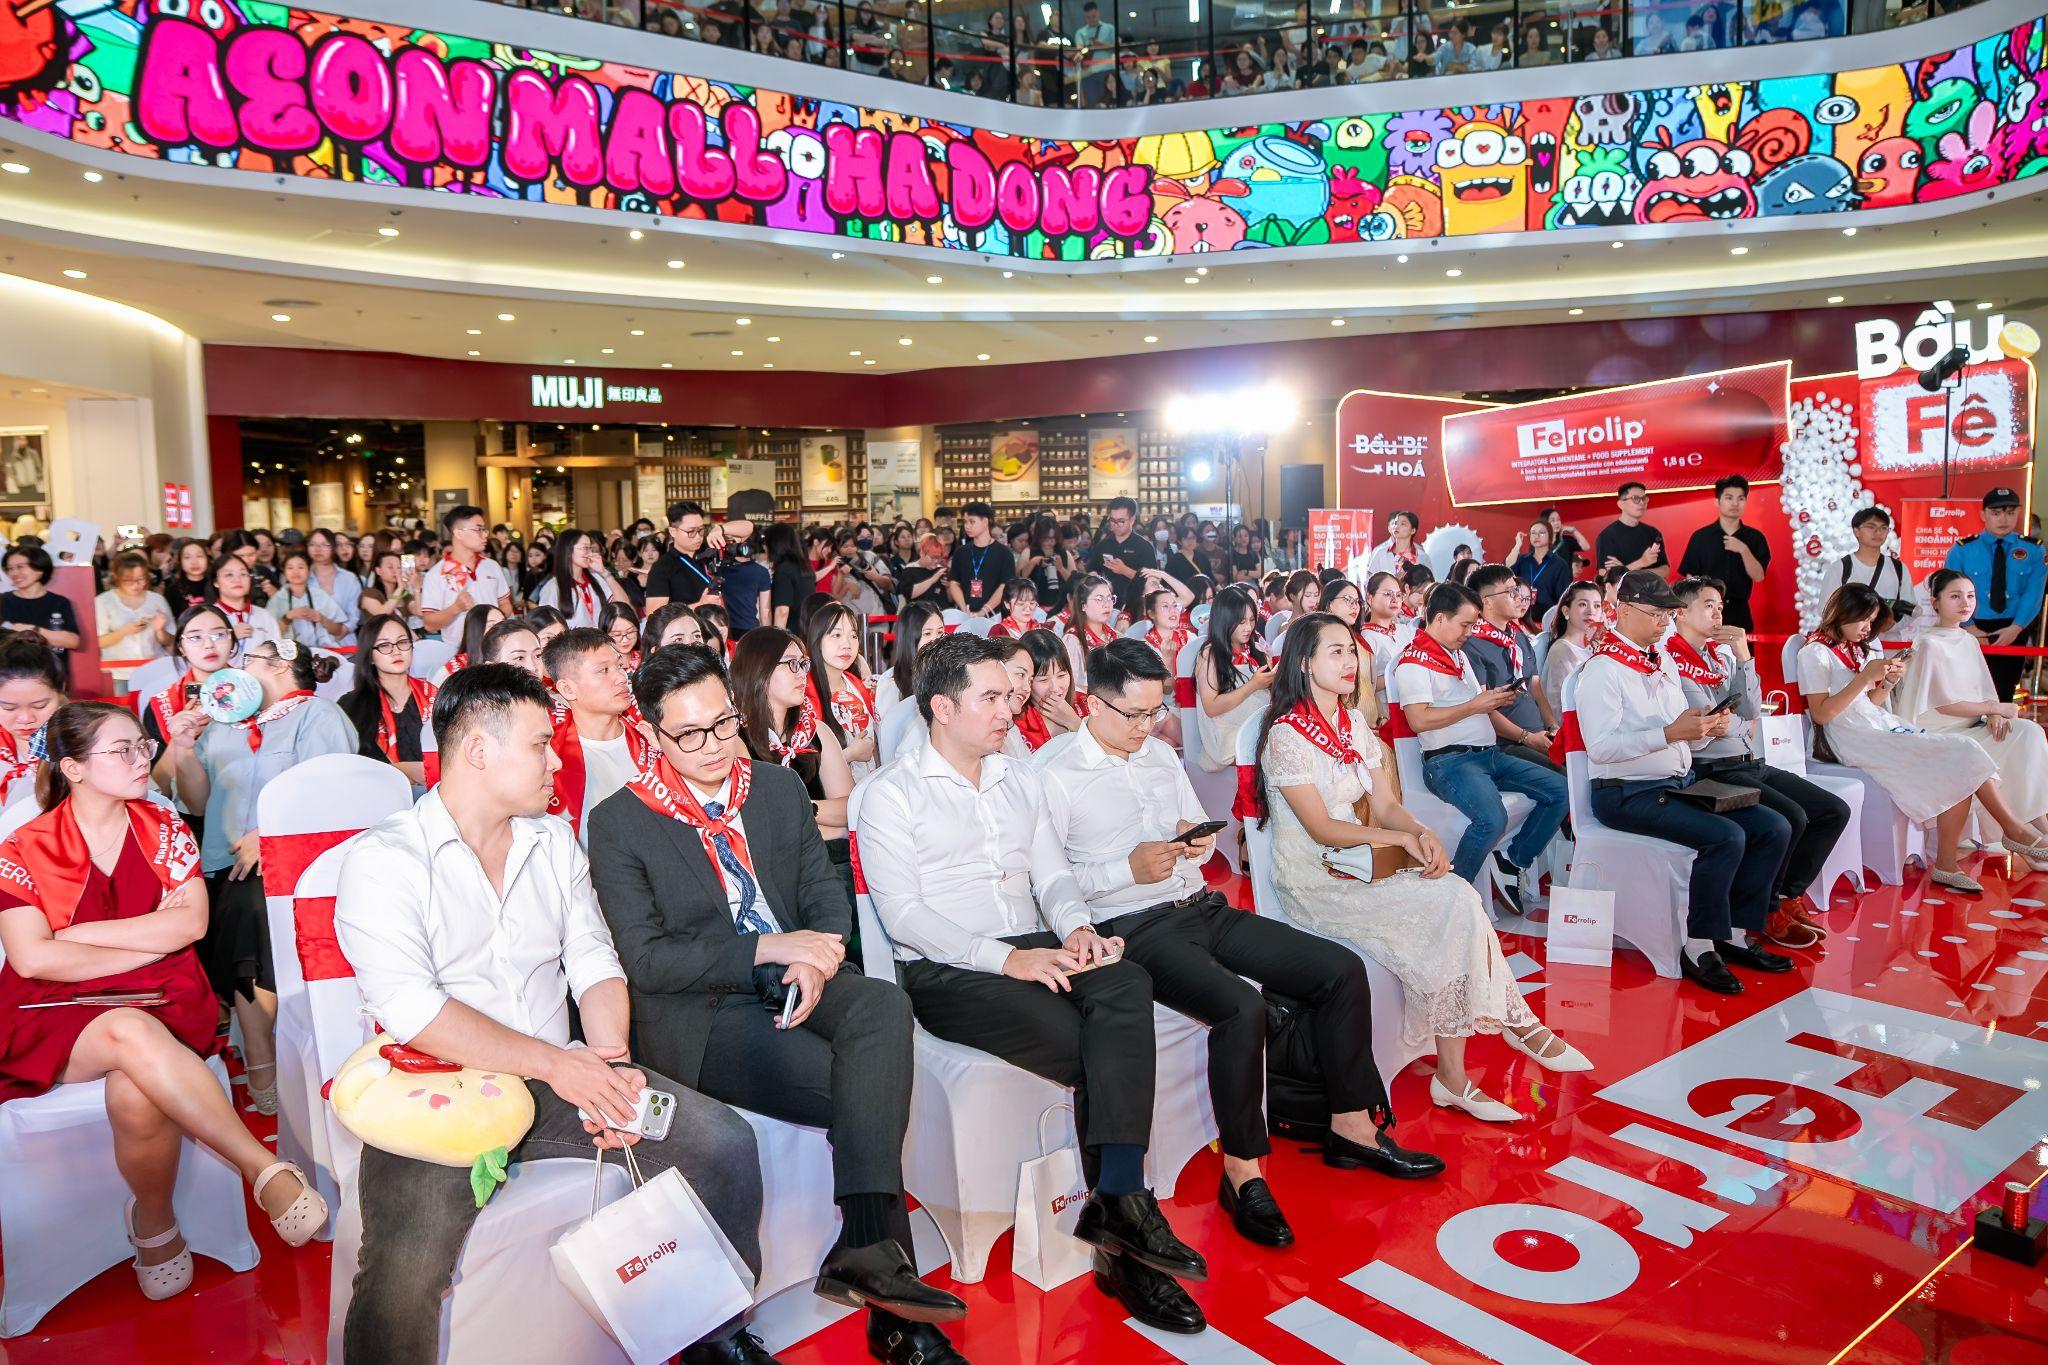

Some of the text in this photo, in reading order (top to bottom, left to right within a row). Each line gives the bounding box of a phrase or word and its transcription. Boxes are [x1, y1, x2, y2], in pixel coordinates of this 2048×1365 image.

[137, 19, 1152, 237] AEON MALL HA DONG
[531, 375, 604, 408] MUJI
[1526, 415, 1645, 451] Ferrolip
[1906, 392, 1997, 454] Fê
[1385, 460, 1426, 477] HOÁ
[1592, 451, 1610, 460] FOOD
[1611, 446, 1655, 458] SUPPLEMENT
[744, 513, 773, 521] WAFFLE
[154, 823, 170, 865] FERROLIP
[1566, 914, 1597, 926] Ferrolip
[1053, 1190, 1091, 1212] Ferrolip
[619, 1239, 678, 1282] Ferrolip
